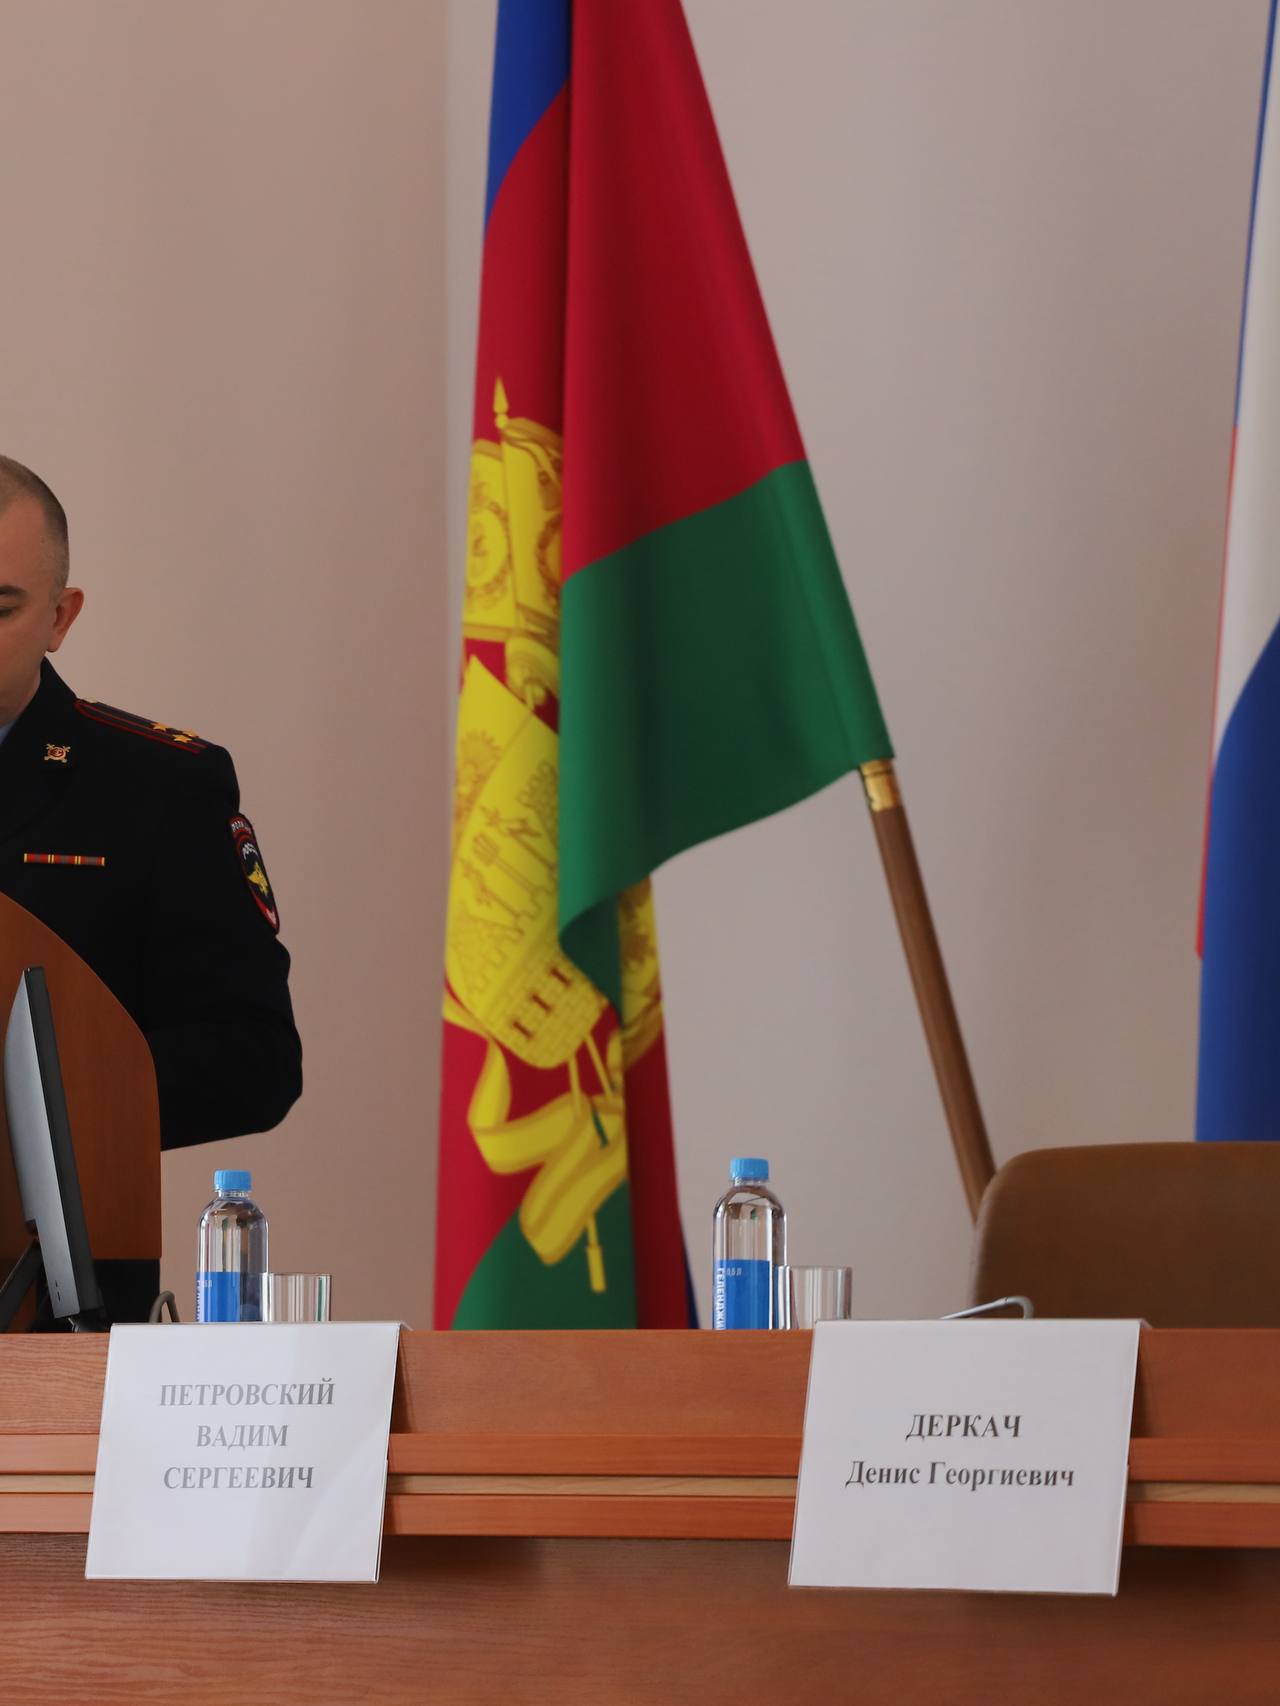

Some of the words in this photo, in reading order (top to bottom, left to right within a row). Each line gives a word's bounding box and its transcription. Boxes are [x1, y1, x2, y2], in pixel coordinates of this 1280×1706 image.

[716, 1267, 726, 1329] ГЕЛЕНДЖИ
[160, 1377, 335, 1406] ПЕТРОВСКИЙ
[196, 1425, 288, 1451] ВАДИМ
[905, 1414, 1022, 1441] ДЕРКАЧ
[163, 1466, 314, 1490] СЕРГЕЕВИЧ
[845, 1461, 920, 1488] Денис
[928, 1461, 1074, 1491] Георгиевич
